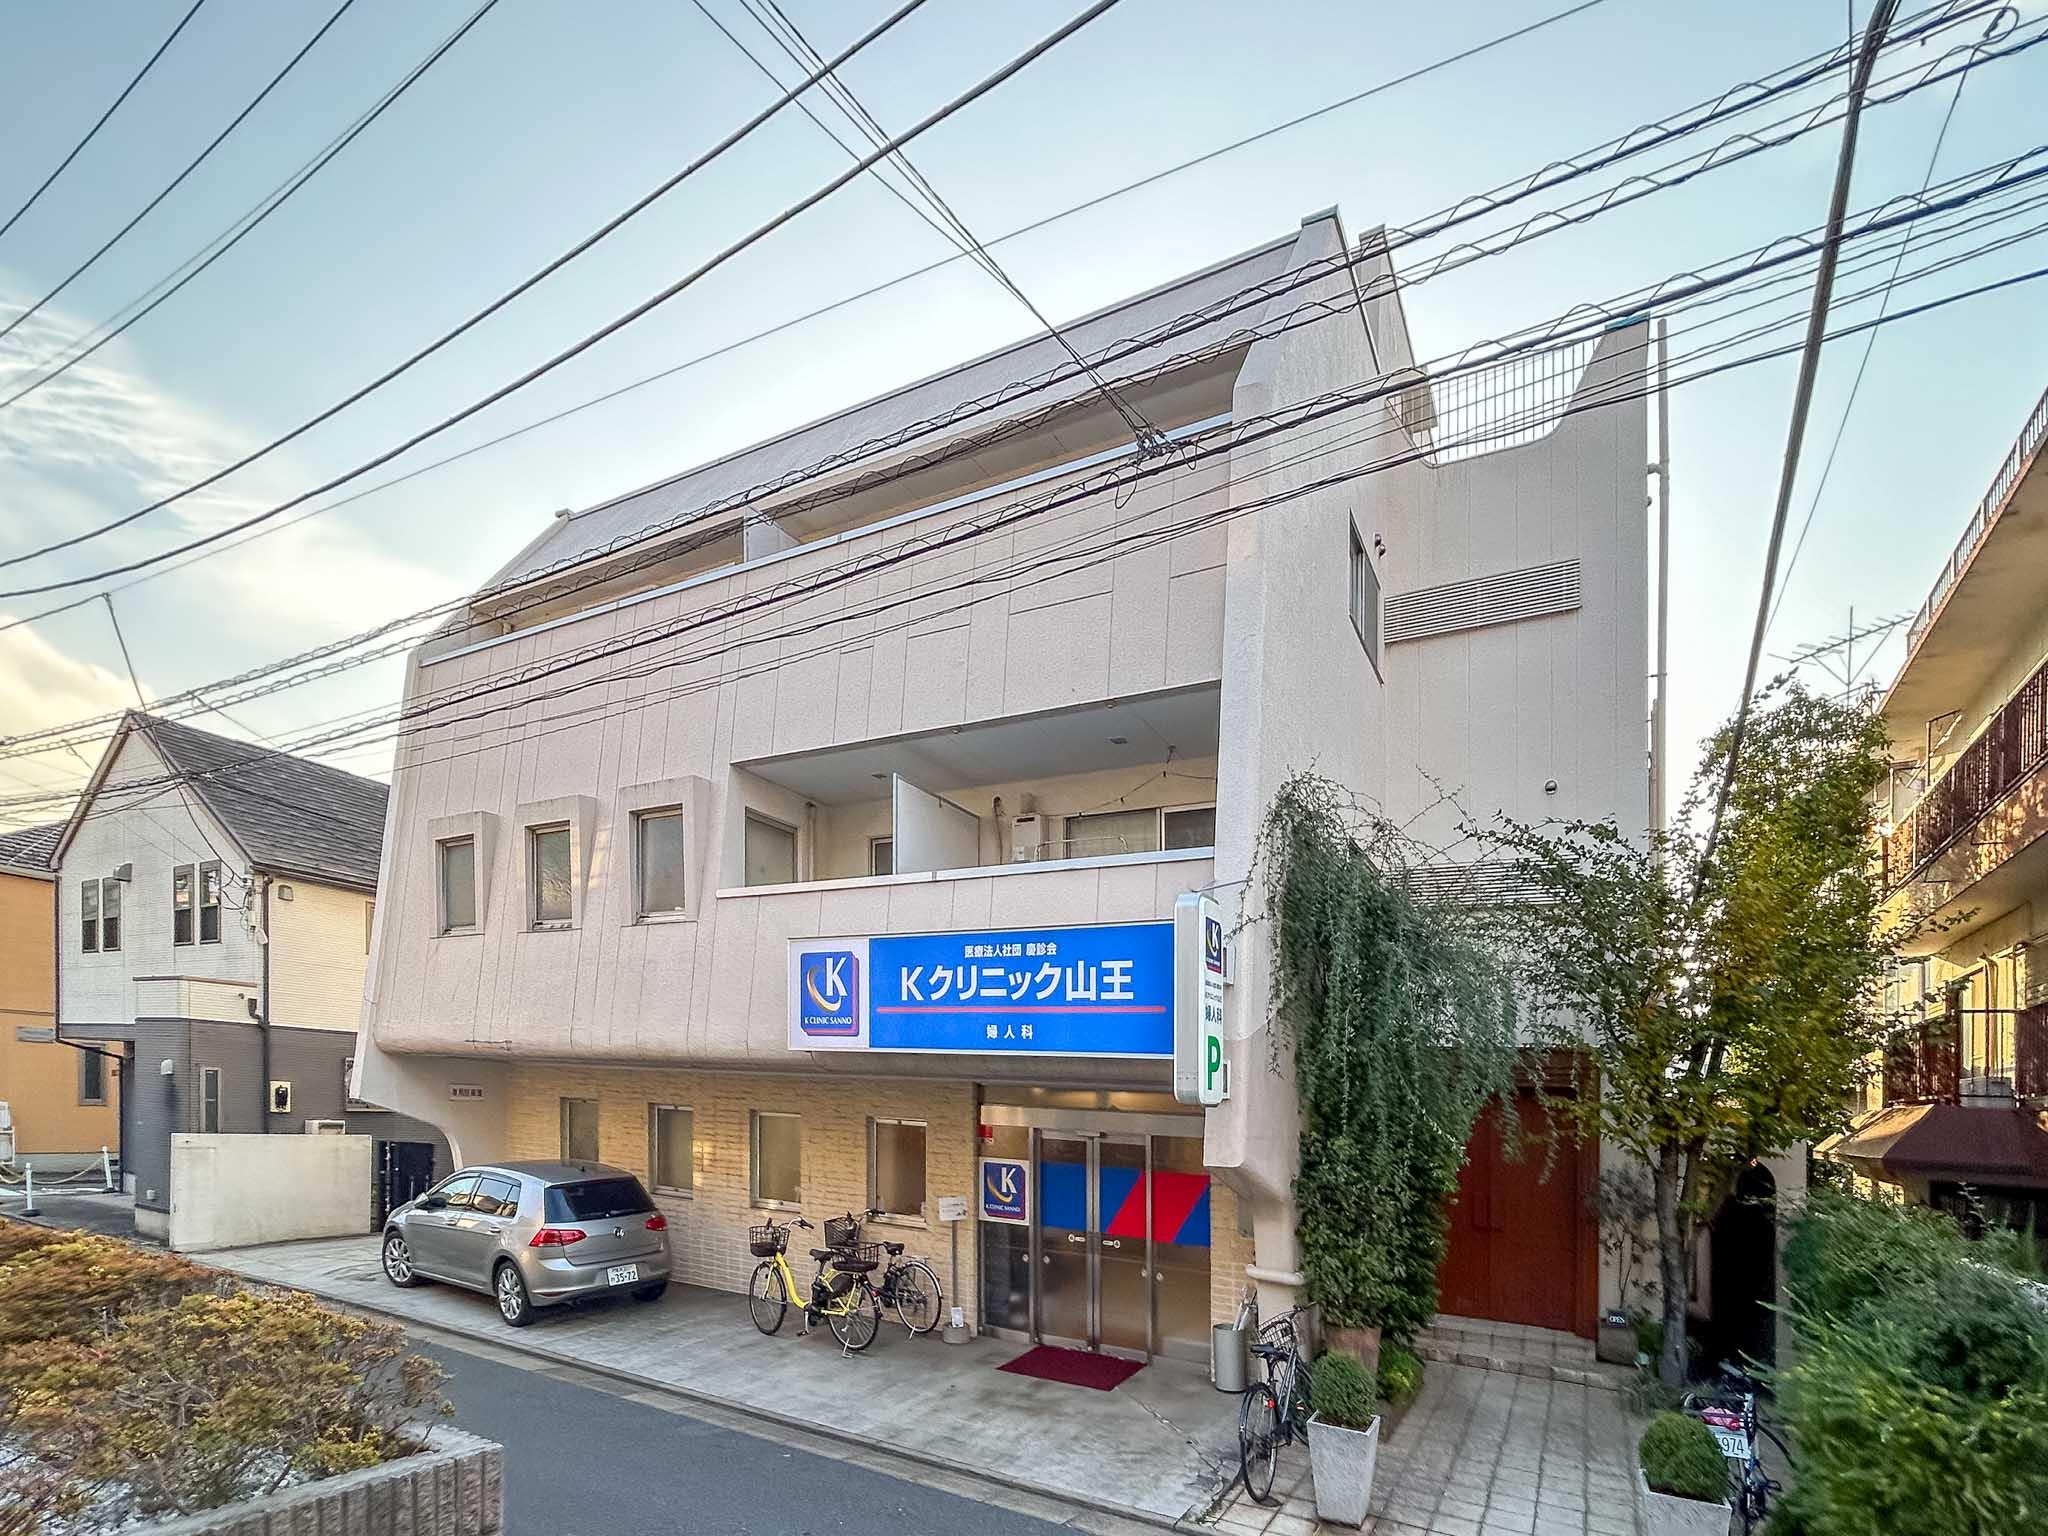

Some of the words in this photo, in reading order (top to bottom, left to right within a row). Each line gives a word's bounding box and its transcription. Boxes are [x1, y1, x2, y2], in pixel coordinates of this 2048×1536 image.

[1211, 922, 1220, 950] K
[826, 956, 849, 997] K
[809, 1016, 830, 1025] CLINIC
[830, 1016, 853, 1025] SANNO
[1207, 1035, 1221, 1090] P
[1001, 1167, 1017, 1194] K
